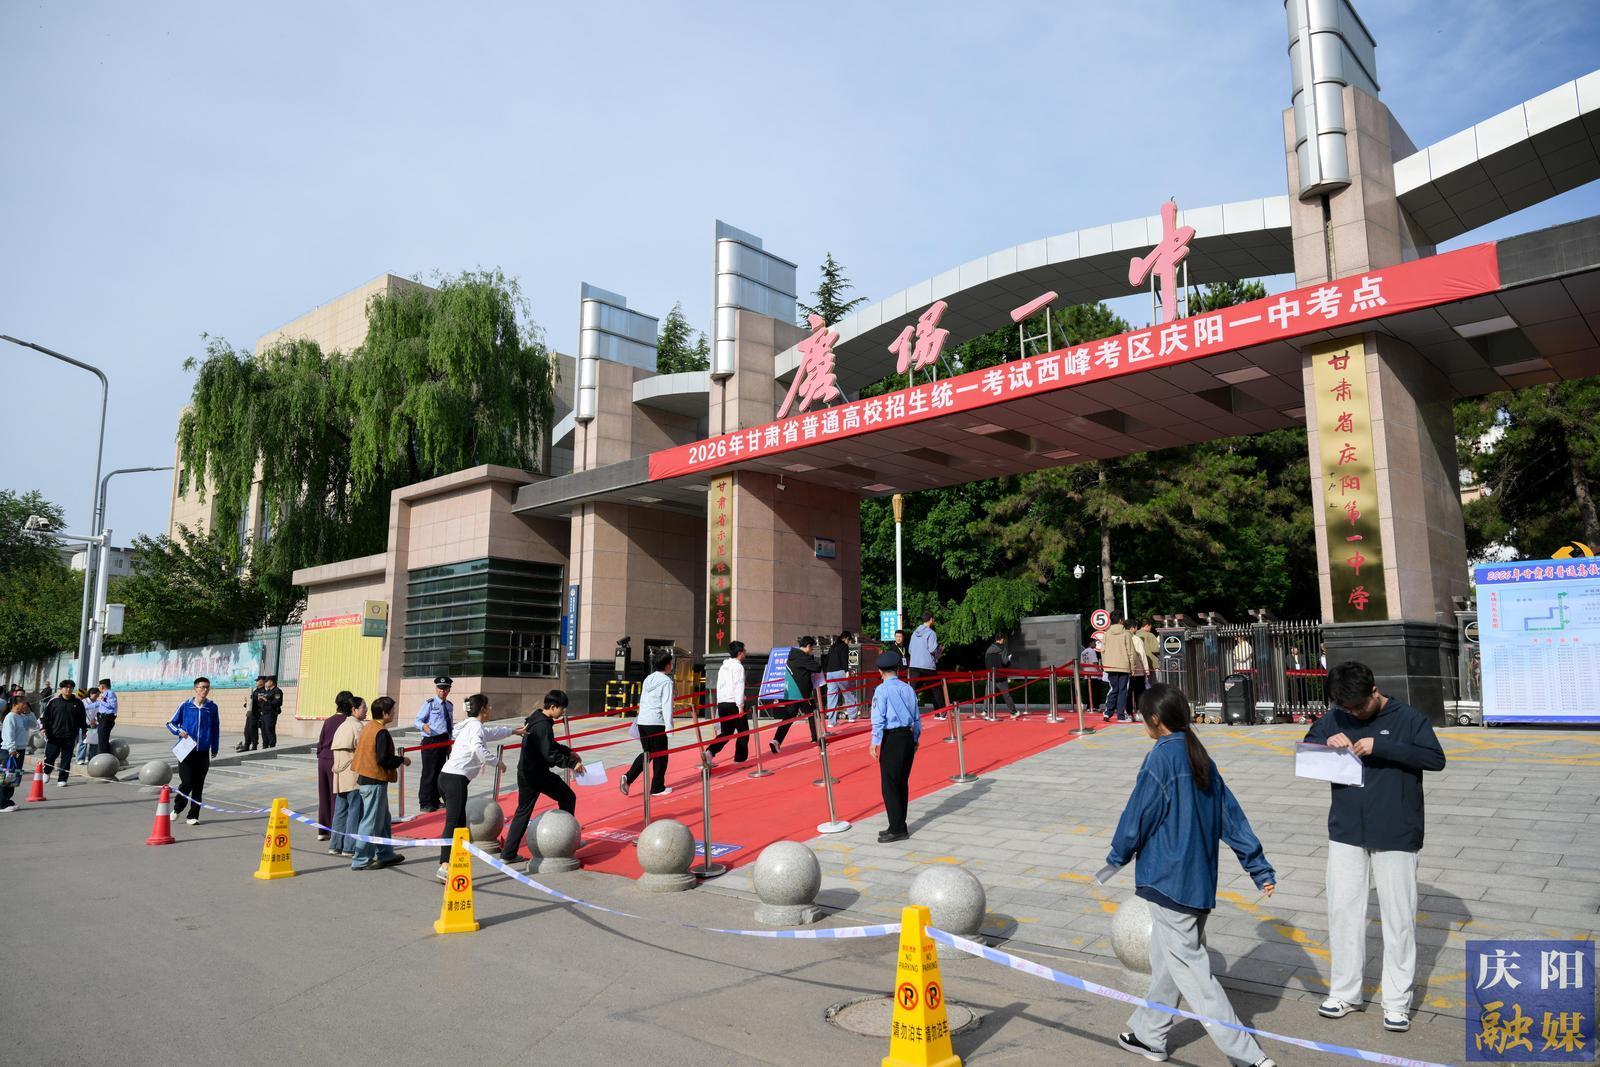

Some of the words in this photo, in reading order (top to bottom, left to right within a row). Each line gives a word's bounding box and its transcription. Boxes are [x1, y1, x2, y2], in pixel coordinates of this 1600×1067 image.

[687, 275, 1388, 466] 2026年甘肃省普通高校招生统一考试西峰考区庆阳一中考点
[1327, 350, 1370, 611] 甘肃省庆阳第一中学
[1096, 614, 1105, 626] 5
[448, 900, 471, 911] 请勿泊车
[905, 953, 912, 961] NO
[899, 962, 918, 972] PARKING
[893, 1021, 923, 1043] 请勿泊车
[925, 1019, 948, 1042] 请勿泊车
